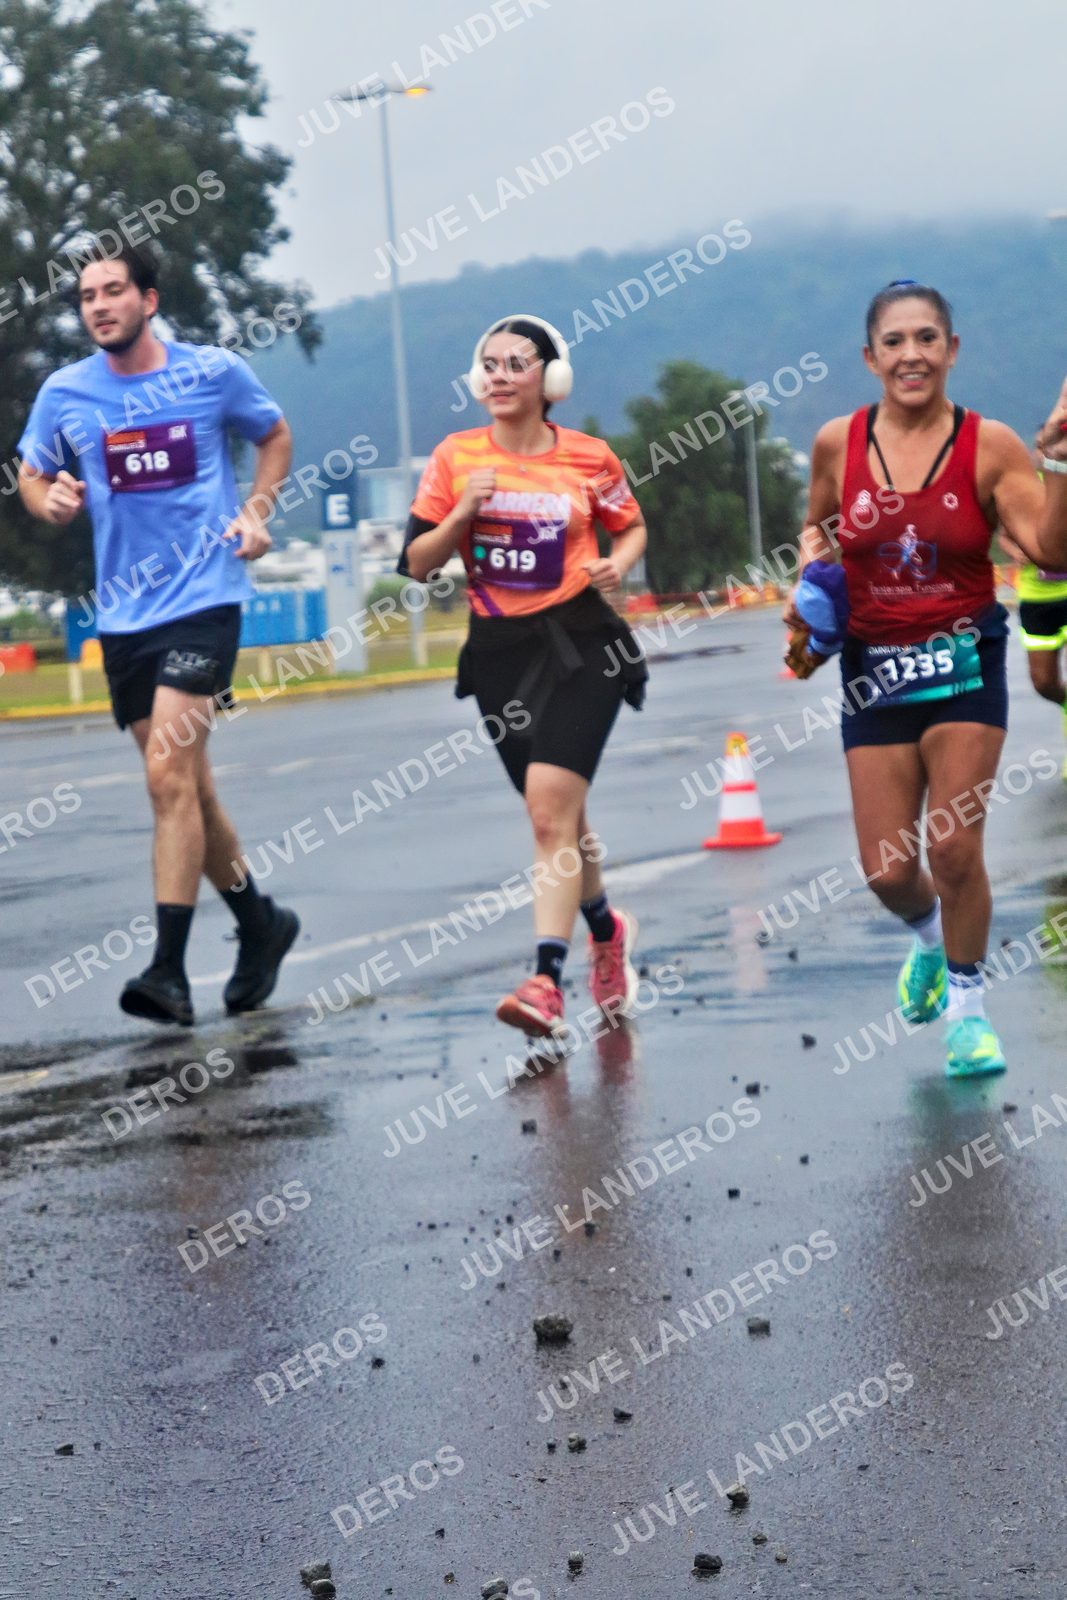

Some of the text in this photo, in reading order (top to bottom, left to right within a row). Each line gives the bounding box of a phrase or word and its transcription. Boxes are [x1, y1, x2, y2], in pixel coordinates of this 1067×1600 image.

[125, 450, 170, 475] 618
[326, 493, 351, 526] E
[489, 547, 537, 572] 619
[883, 648, 954, 682] 1235
